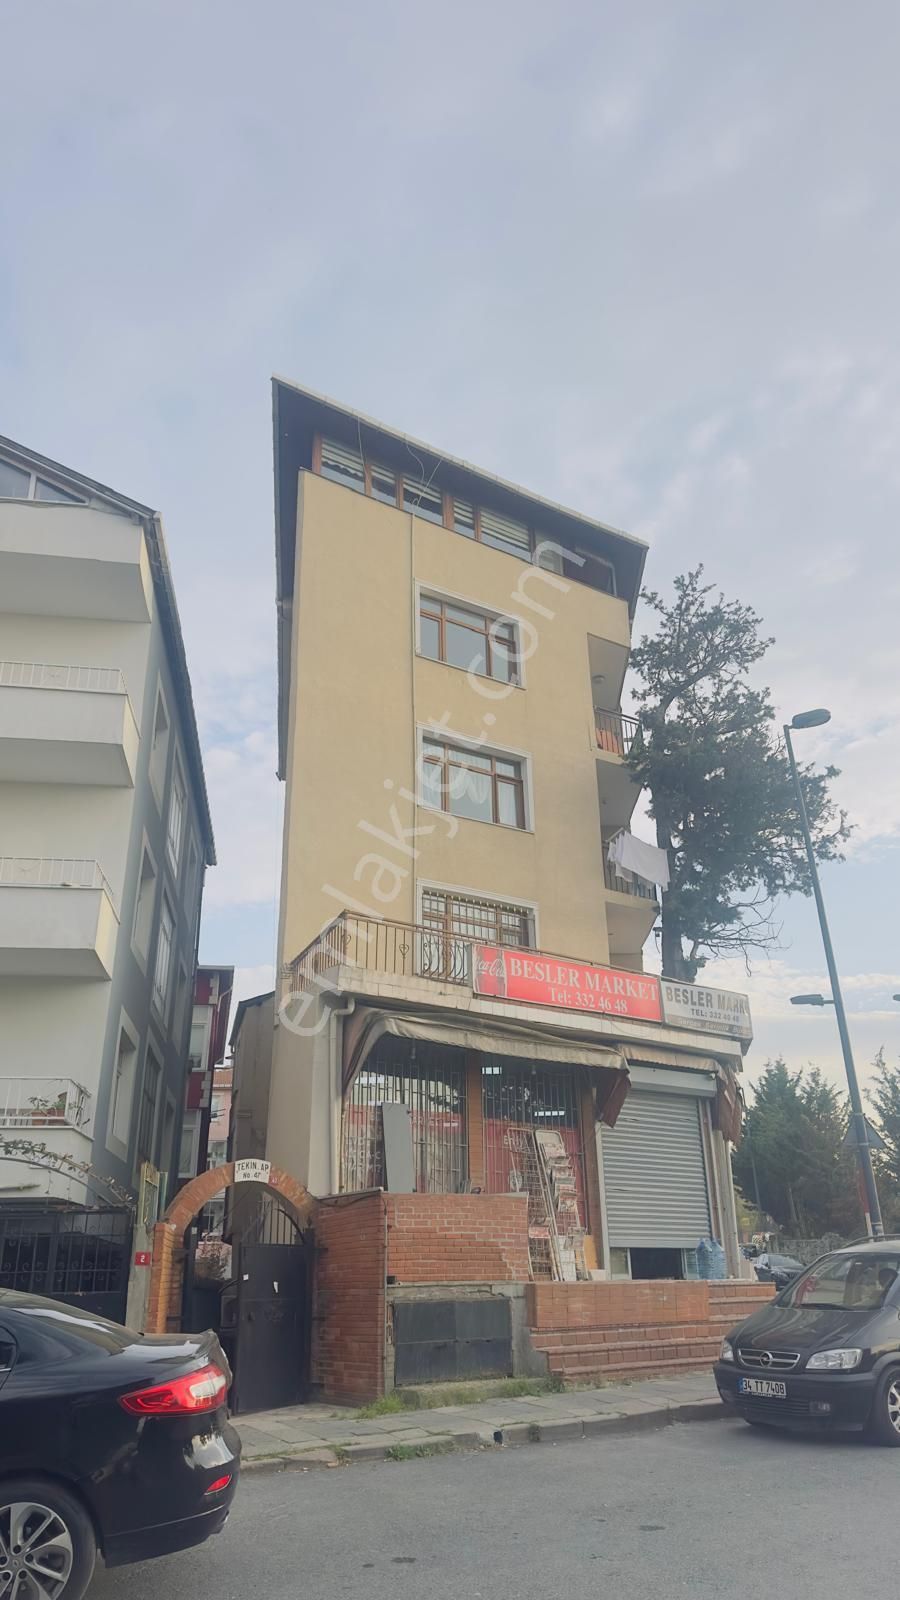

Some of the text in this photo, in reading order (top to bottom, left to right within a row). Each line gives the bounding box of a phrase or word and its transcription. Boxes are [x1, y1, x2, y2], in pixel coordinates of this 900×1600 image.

[510, 958, 658, 1001] BESLER MARKET
[549, 987, 628, 1013] Tel: 332 46 48
[665, 986, 713, 1008] BESLER
[691, 1008, 708, 1018] TEL:
[743, 1379, 752, 1391] 34
[755, 1380, 763, 1392] TT
